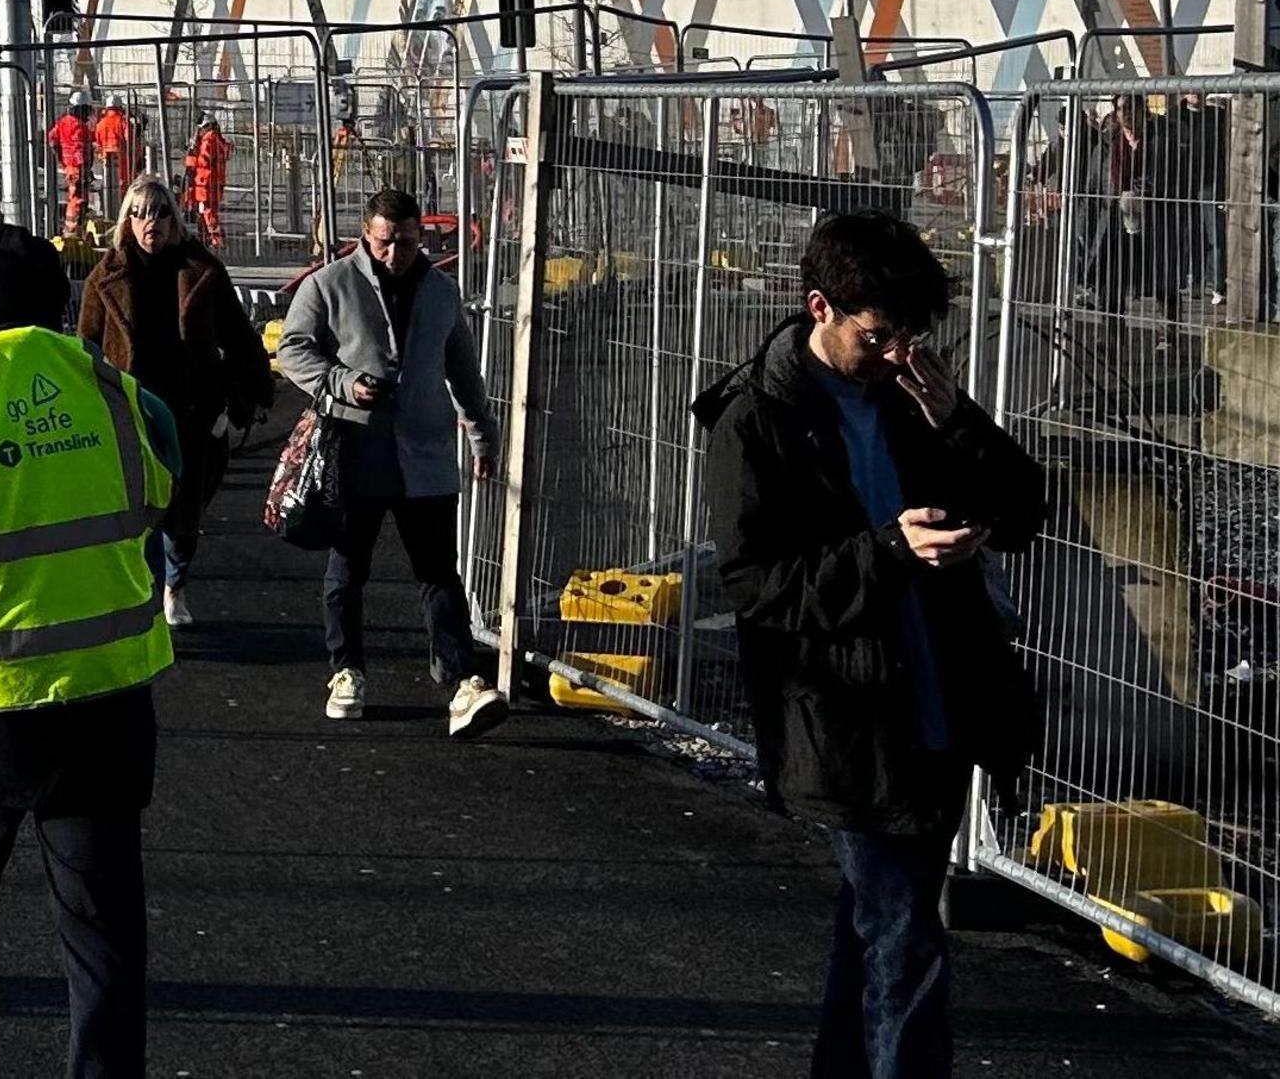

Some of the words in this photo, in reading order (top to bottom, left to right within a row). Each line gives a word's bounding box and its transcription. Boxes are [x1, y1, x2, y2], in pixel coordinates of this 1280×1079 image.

[6, 399, 29, 423] go
[25, 406, 73, 436] safe
[25, 431, 102, 459] Translink
